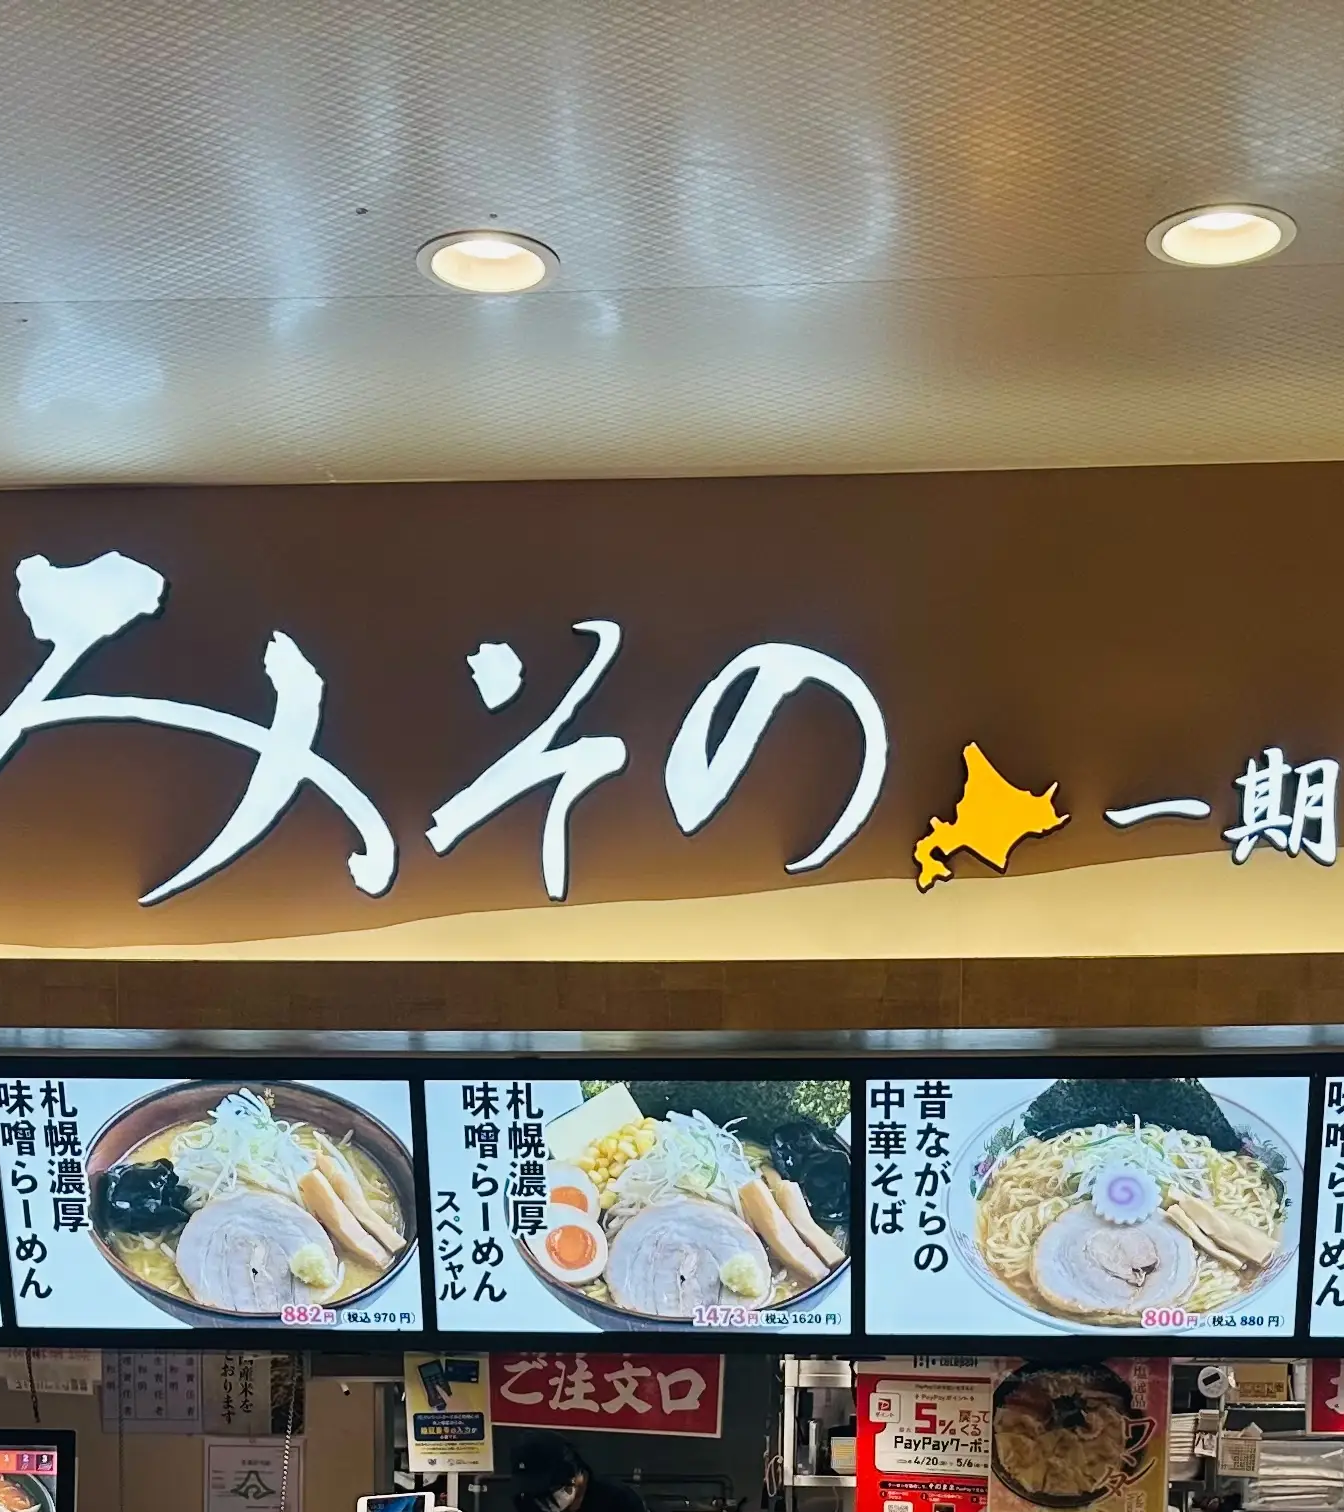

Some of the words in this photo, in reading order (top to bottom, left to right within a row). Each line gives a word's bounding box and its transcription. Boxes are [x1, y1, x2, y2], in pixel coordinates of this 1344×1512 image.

[39, 1080, 90, 1233] 札幌濃厚
[462, 1081, 507, 1303] 味噌らーめん
[506, 1081, 548, 1236] 札幌濃厚
[868, 1081, 907, 1235] 中華そば
[913, 1081, 953, 1274] 昔ながらの
[435, 1191, 466, 1302] スペシャル
[499, 1358, 708, 1415] ご注文口
[959, 1410, 991, 1423] 戻って
[960, 1424, 982, 1437] くる
